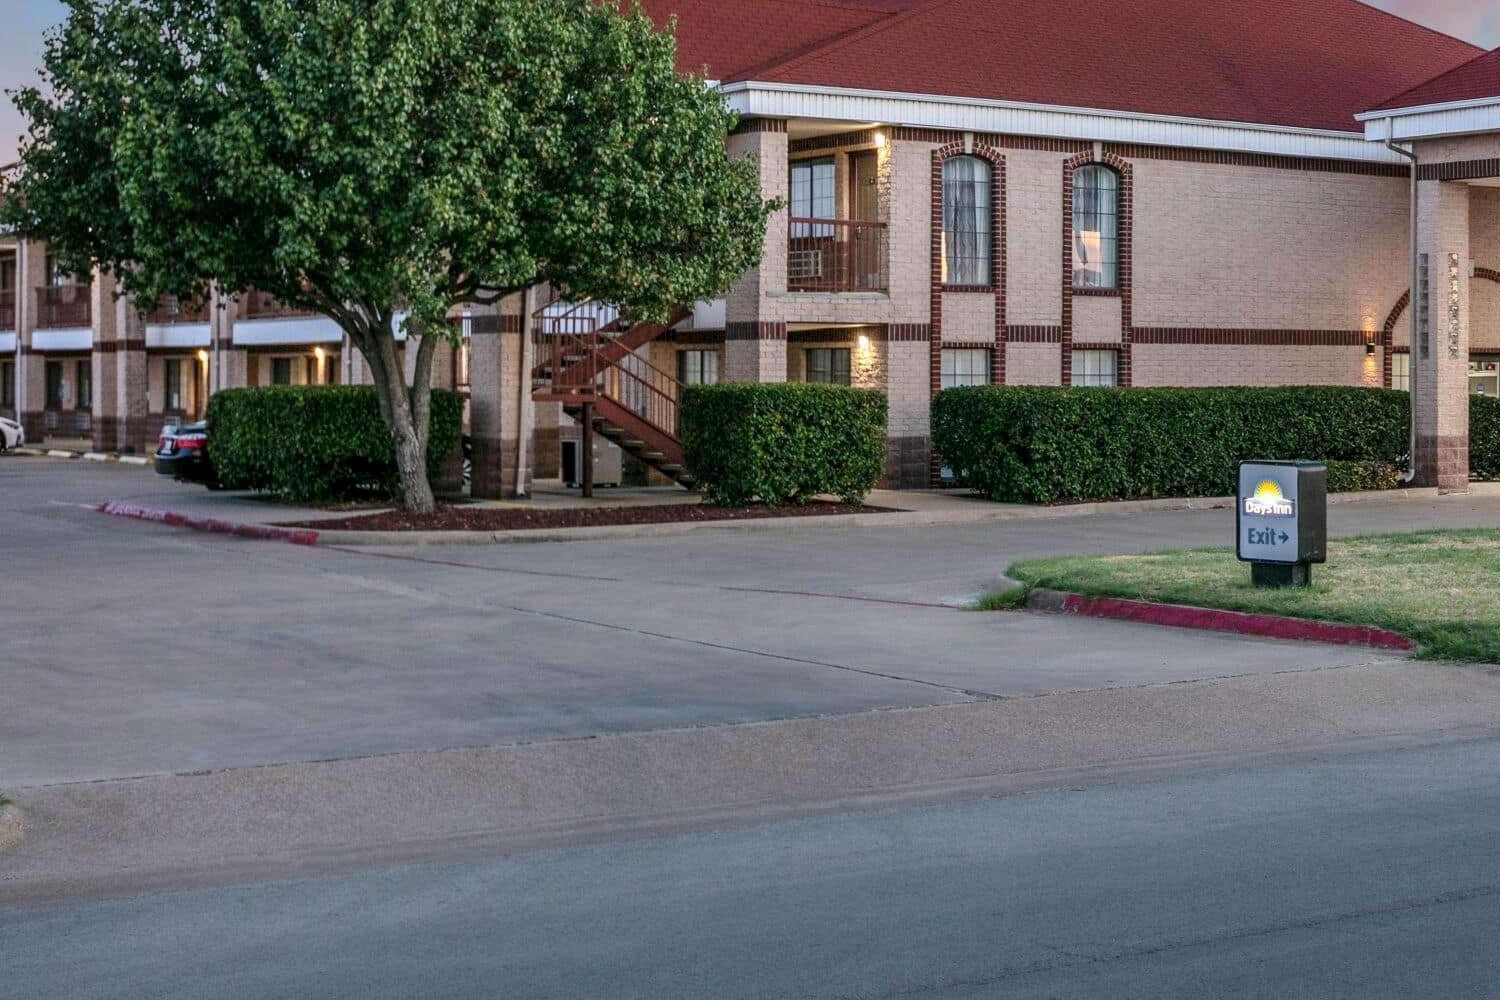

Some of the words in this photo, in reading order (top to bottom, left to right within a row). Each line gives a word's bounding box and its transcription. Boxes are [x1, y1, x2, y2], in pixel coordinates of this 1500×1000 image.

[1245, 501, 1273, 515] Days
[1273, 503, 1292, 515] Inn
[1248, 526, 1276, 546] Exit
